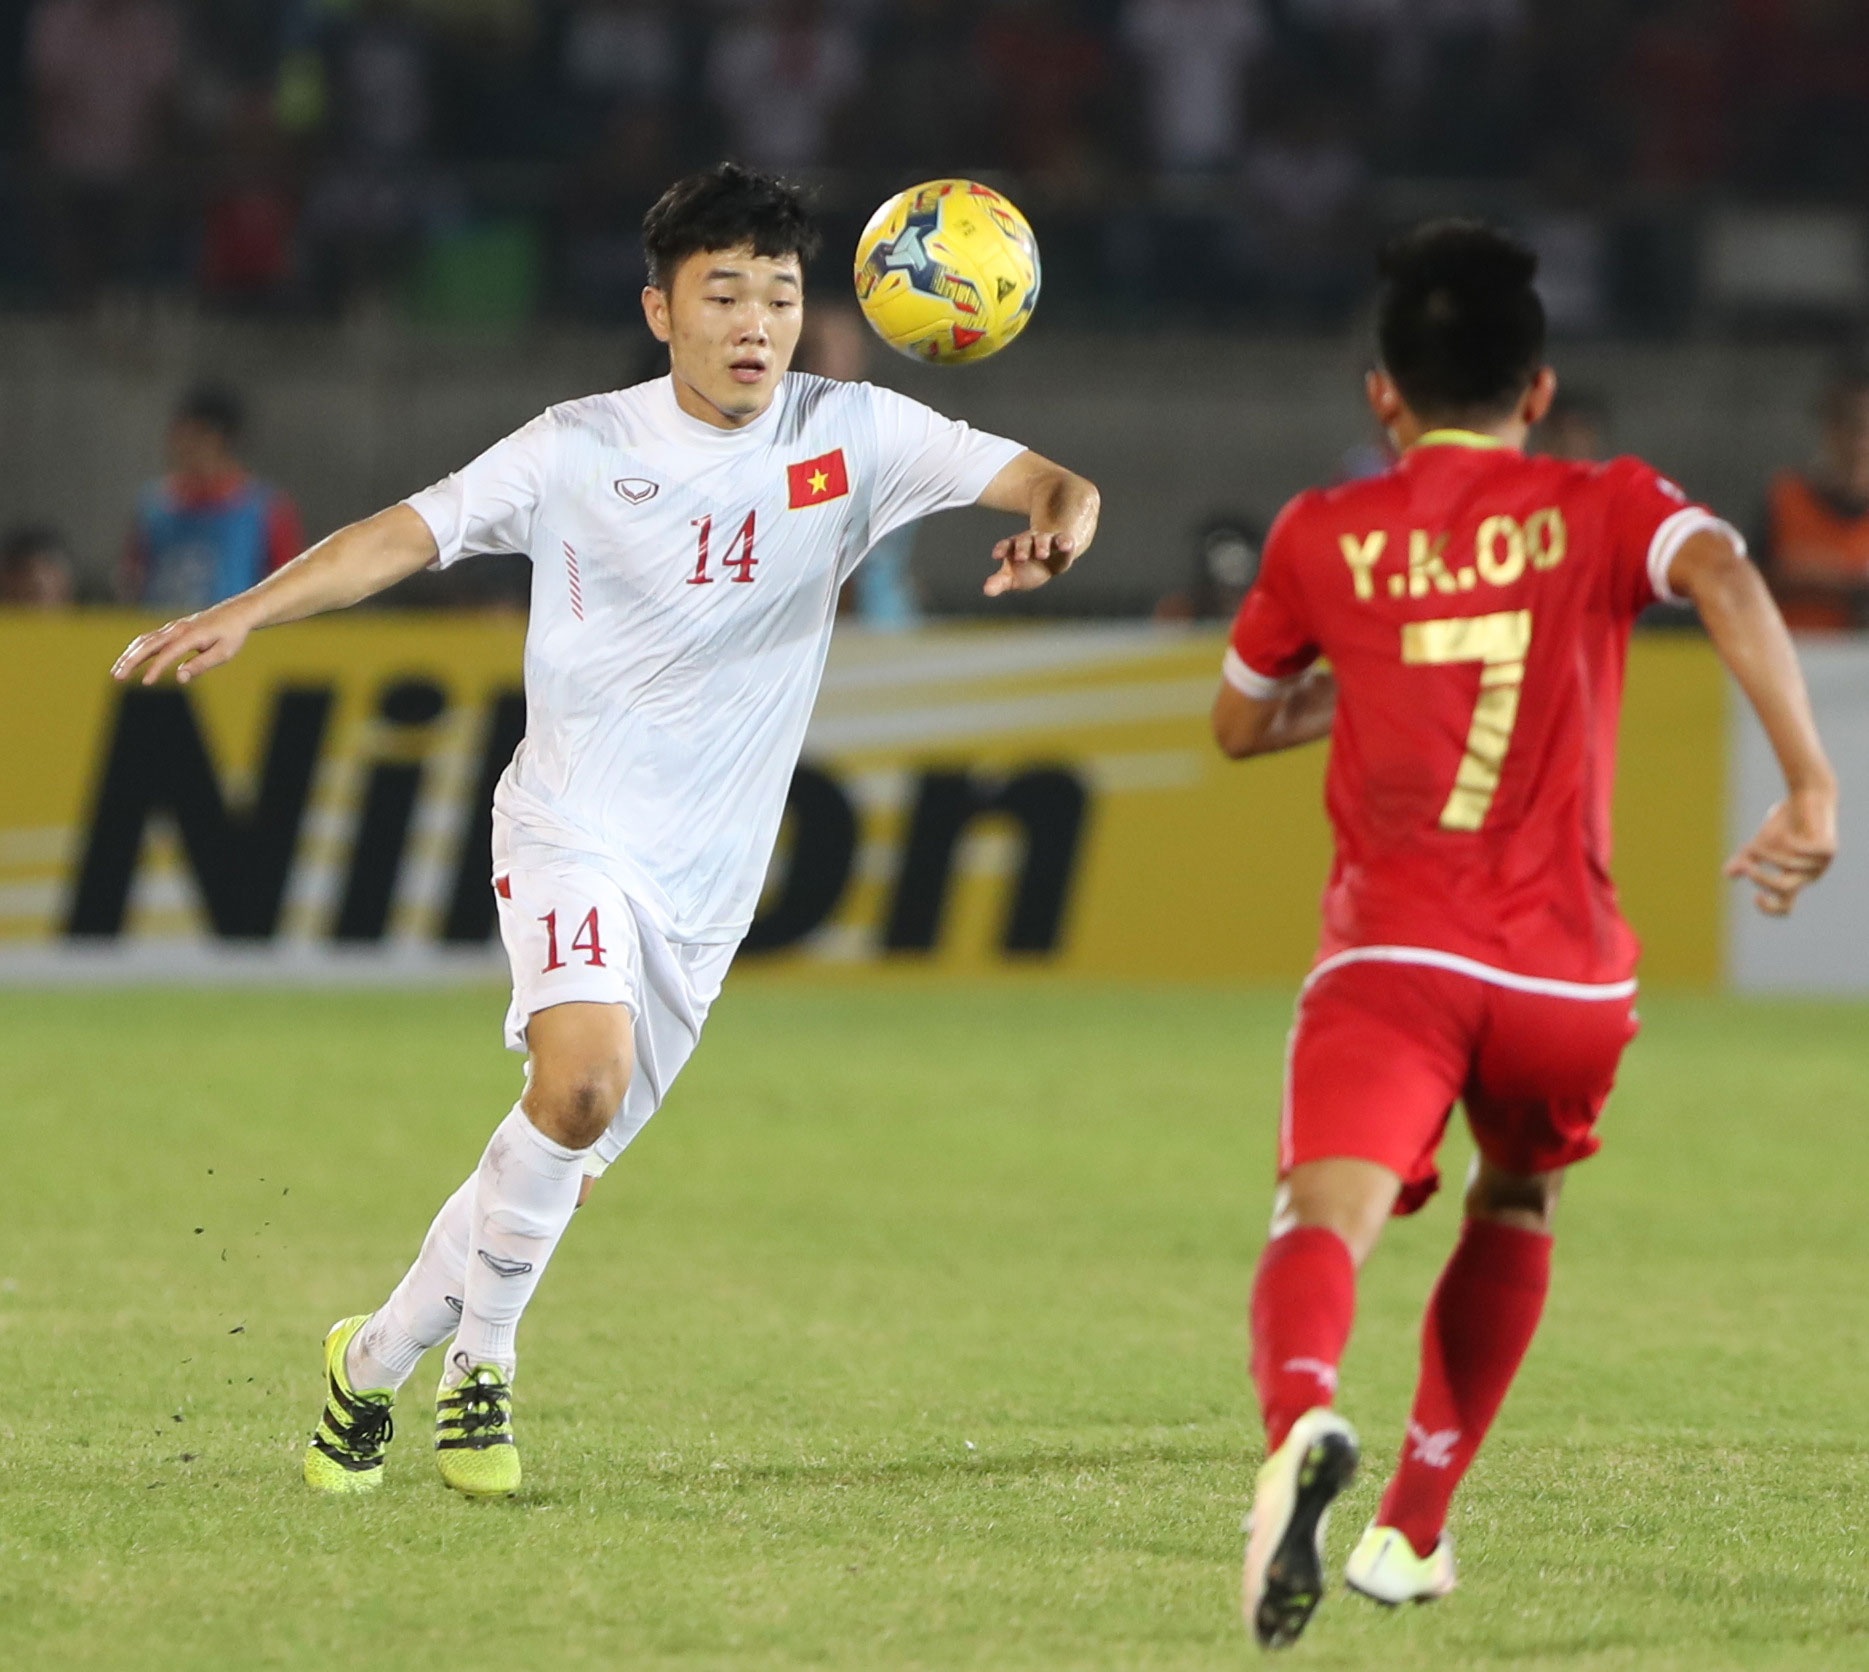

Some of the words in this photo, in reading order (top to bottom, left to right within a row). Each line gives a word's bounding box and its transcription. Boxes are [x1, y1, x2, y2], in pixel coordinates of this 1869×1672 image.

[686, 509, 759, 584] 14
[1339, 506, 1567, 600] Y.K.OO
[1402, 608, 1532, 832] 7
[537, 906, 607, 974] 14
